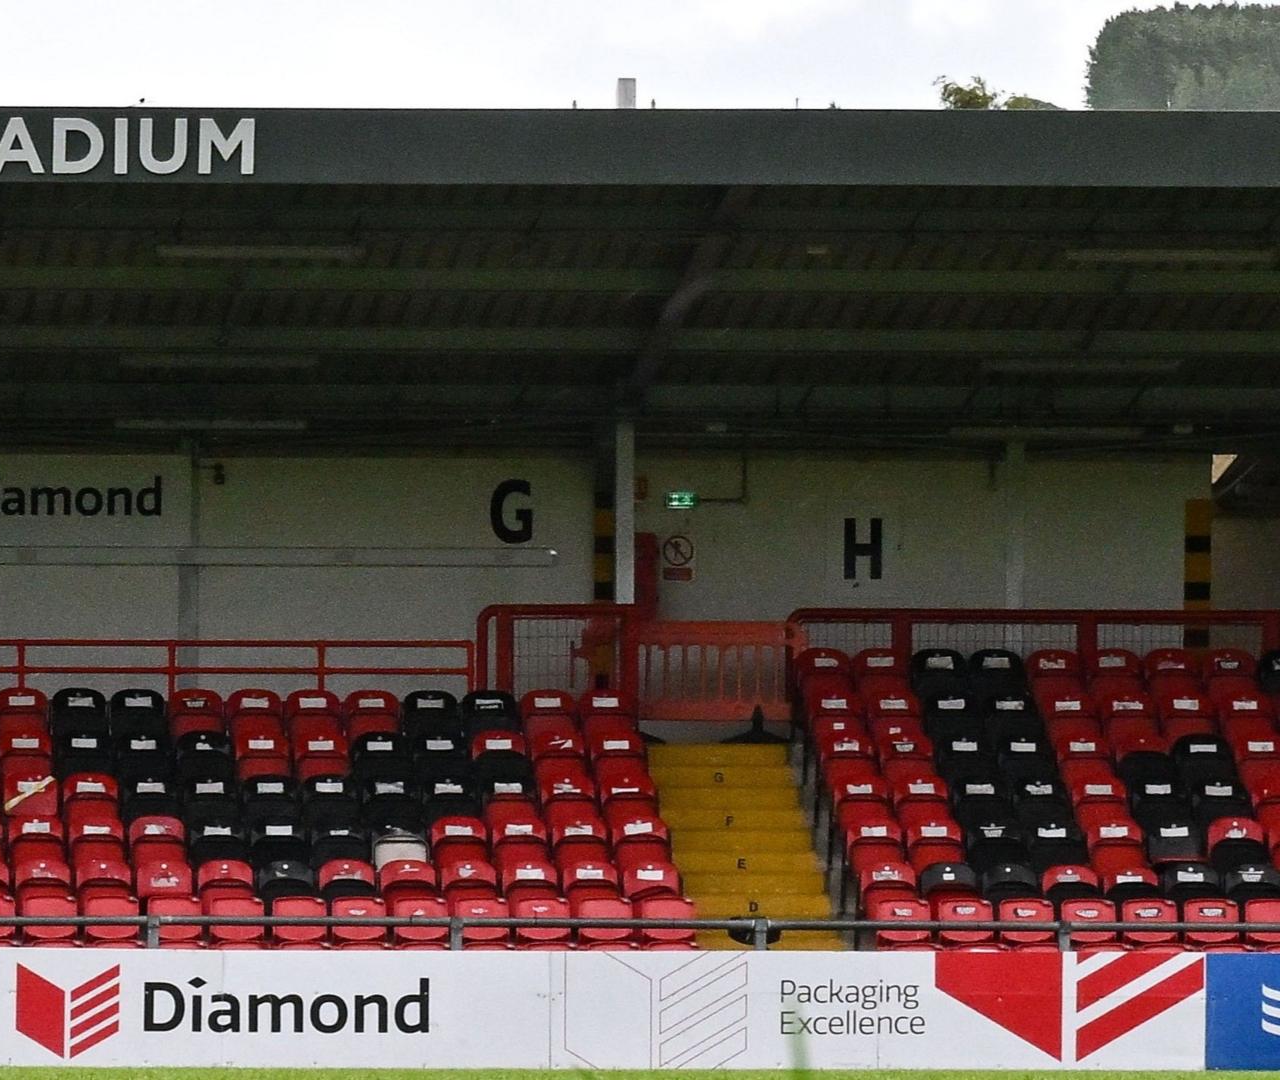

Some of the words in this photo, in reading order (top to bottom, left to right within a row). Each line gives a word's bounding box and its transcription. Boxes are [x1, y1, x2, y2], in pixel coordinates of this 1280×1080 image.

[490, 478, 533, 544] G
[844, 517, 882, 580] H
[713, 772, 724, 784] G
[725, 815, 734, 827] F
[736, 858, 747, 870] E
[748, 901, 759, 913] D
[143, 976, 430, 1034] Diamond
[780, 978, 920, 1010] Packaging
[779, 1009, 926, 1035] Excellence
